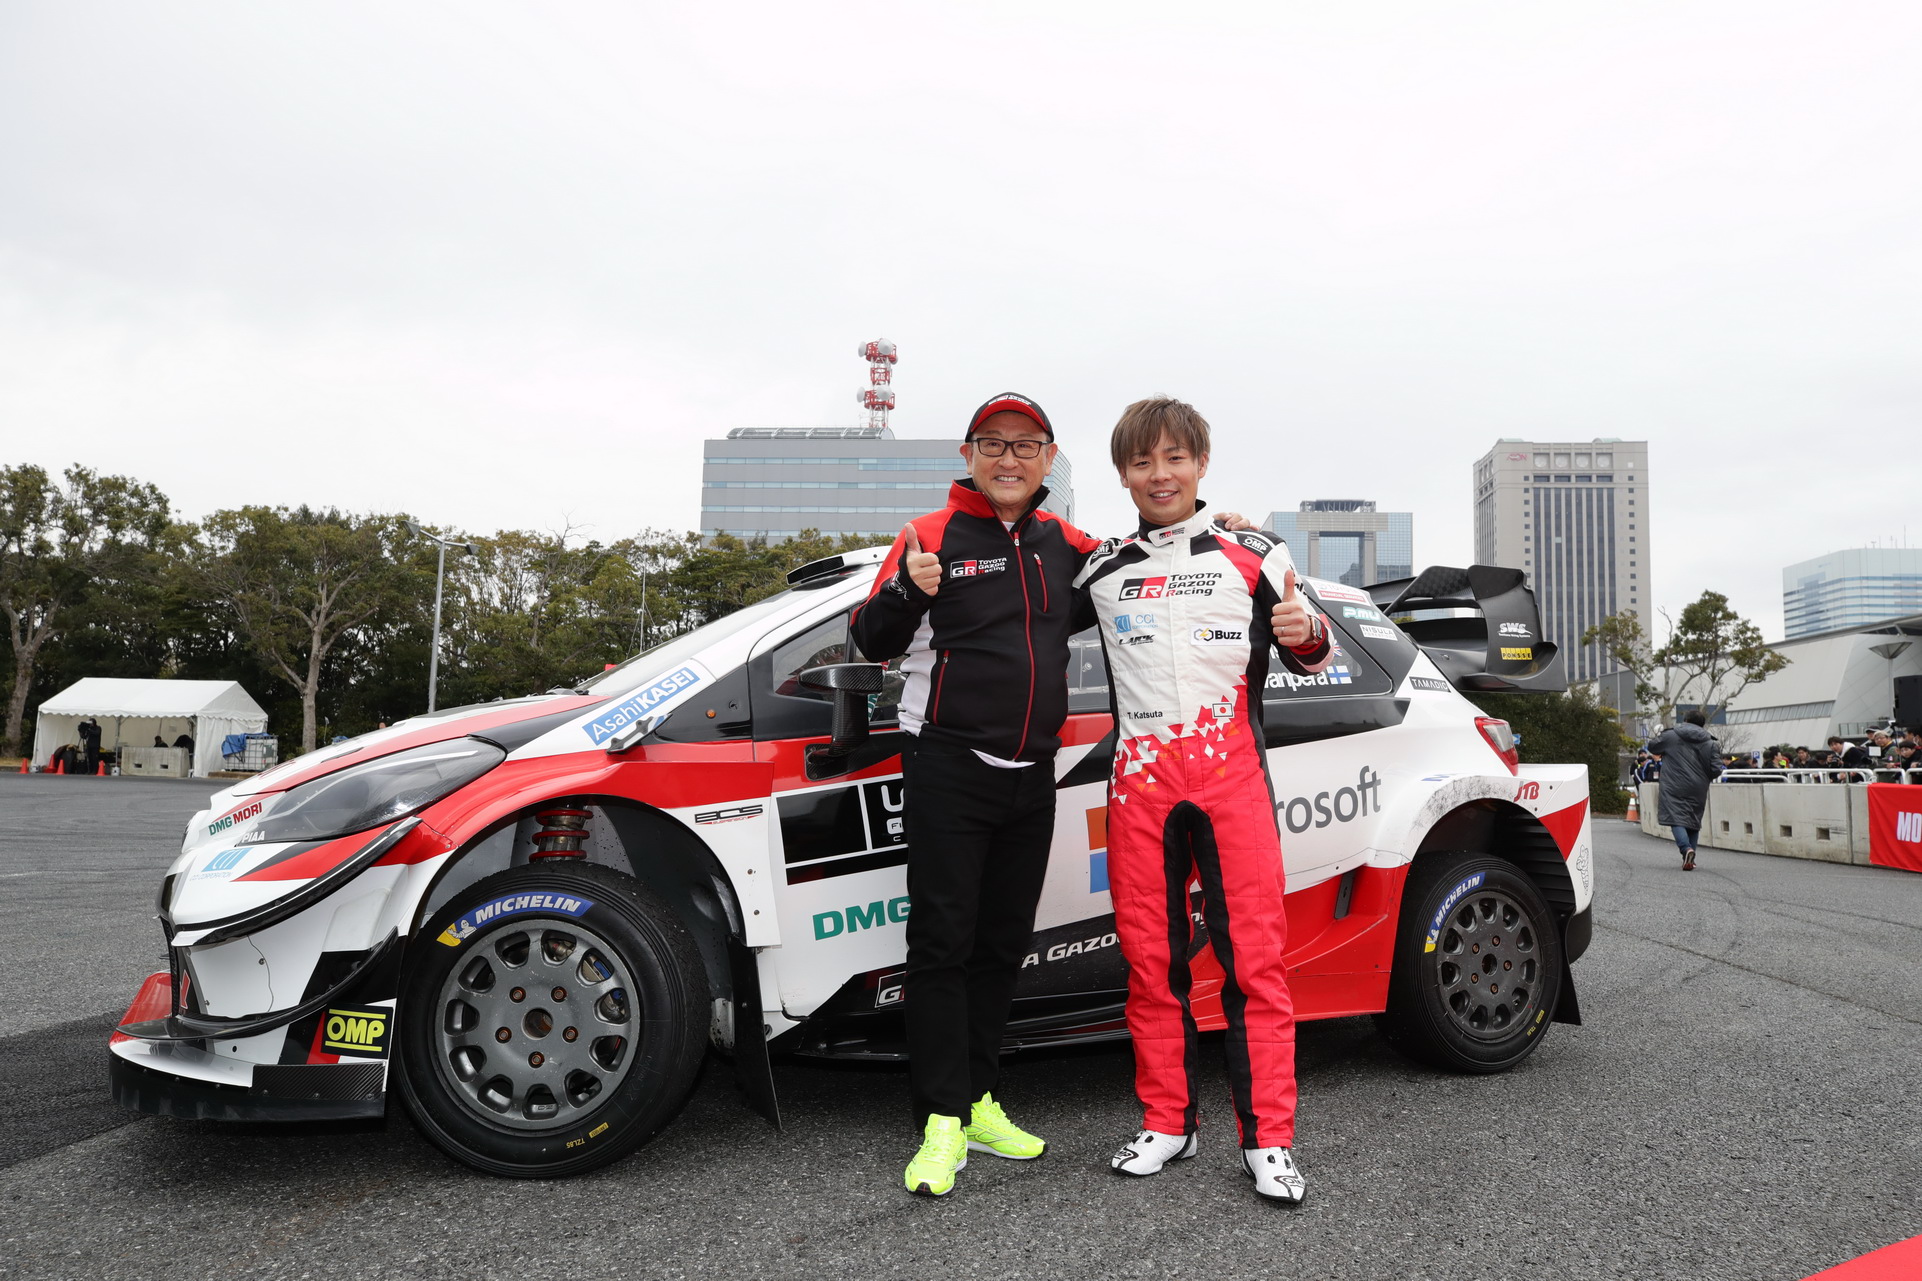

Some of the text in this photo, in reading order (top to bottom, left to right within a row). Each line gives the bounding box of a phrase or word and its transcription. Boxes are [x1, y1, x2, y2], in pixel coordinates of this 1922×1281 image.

[1244, 538, 1267, 551] OMP
[978, 557, 1007, 565] TOYOTA
[978, 562, 1005, 570] GAZOO
[952, 566, 976, 577] GR
[1170, 572, 1222, 581] TOYOTA
[1168, 580, 1216, 589] GAZOO
[1120, 585, 1162, 599] GR
[1165, 587, 1213, 597] Racing
[1135, 614, 1154, 624] CCI
[1362, 626, 1394, 636] NISULA
[1499, 622, 1526, 634] SWS
[1411, 678, 1448, 690] TAMADIC
[1133, 710, 1163, 720] Katsuta
[1513, 781, 1540, 802] JTB
[208, 802, 263, 836] DMG MORI
[241, 831, 265, 843] PIAA
[1435, 875, 1480, 928] MICHELIN
[475, 895, 582, 924] MICHELIN
[812, 895, 911, 941] DMG
[878, 984, 905, 1005] G
[327, 1016, 385, 1045] OMP
